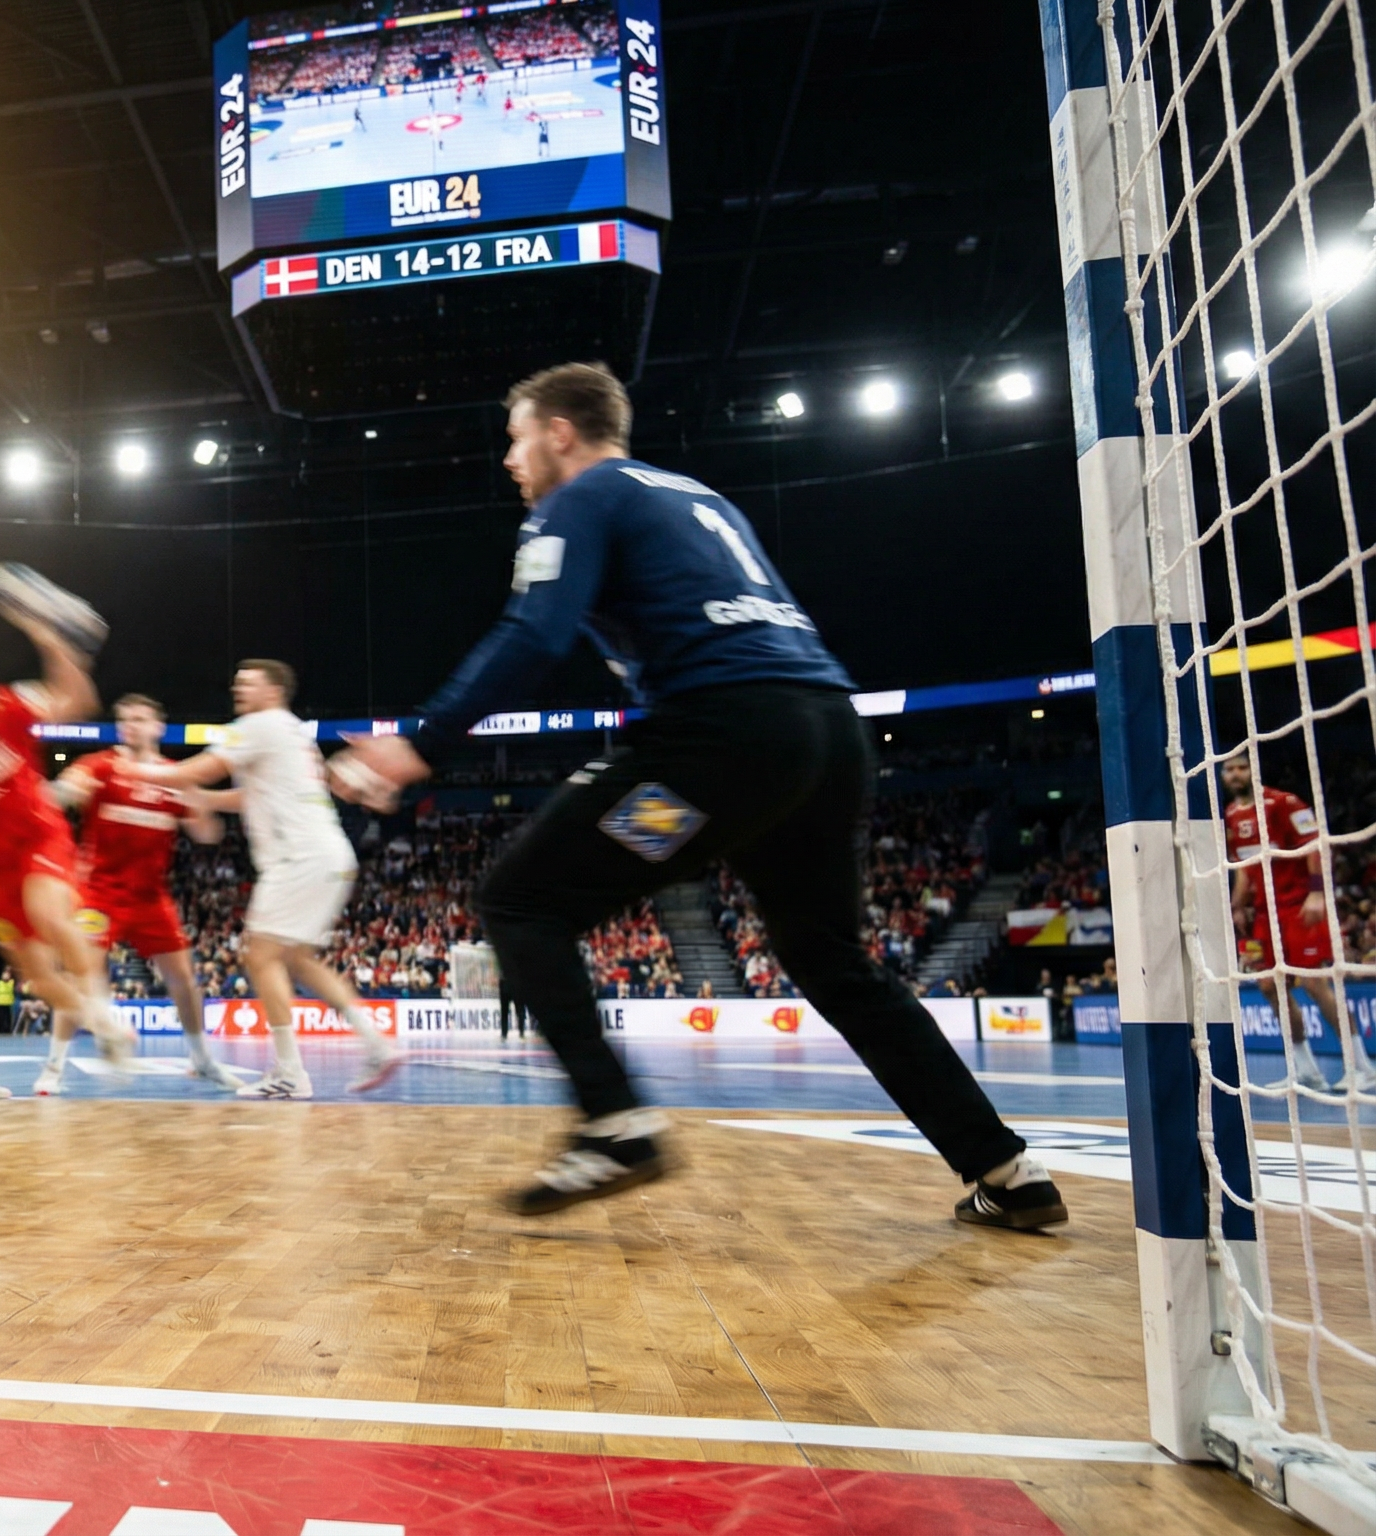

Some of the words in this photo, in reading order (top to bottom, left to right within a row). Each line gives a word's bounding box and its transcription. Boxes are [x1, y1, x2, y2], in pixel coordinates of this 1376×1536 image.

[389, 179, 441, 217] EUR
[445, 174, 481, 210] 24
[325, 253, 382, 286] DEN
[394, 242, 483, 278] 14-12
[495, 235, 553, 267] FRA
[692, 502, 773, 586] 1
[265, 1006, 393, 1031] TRASS
